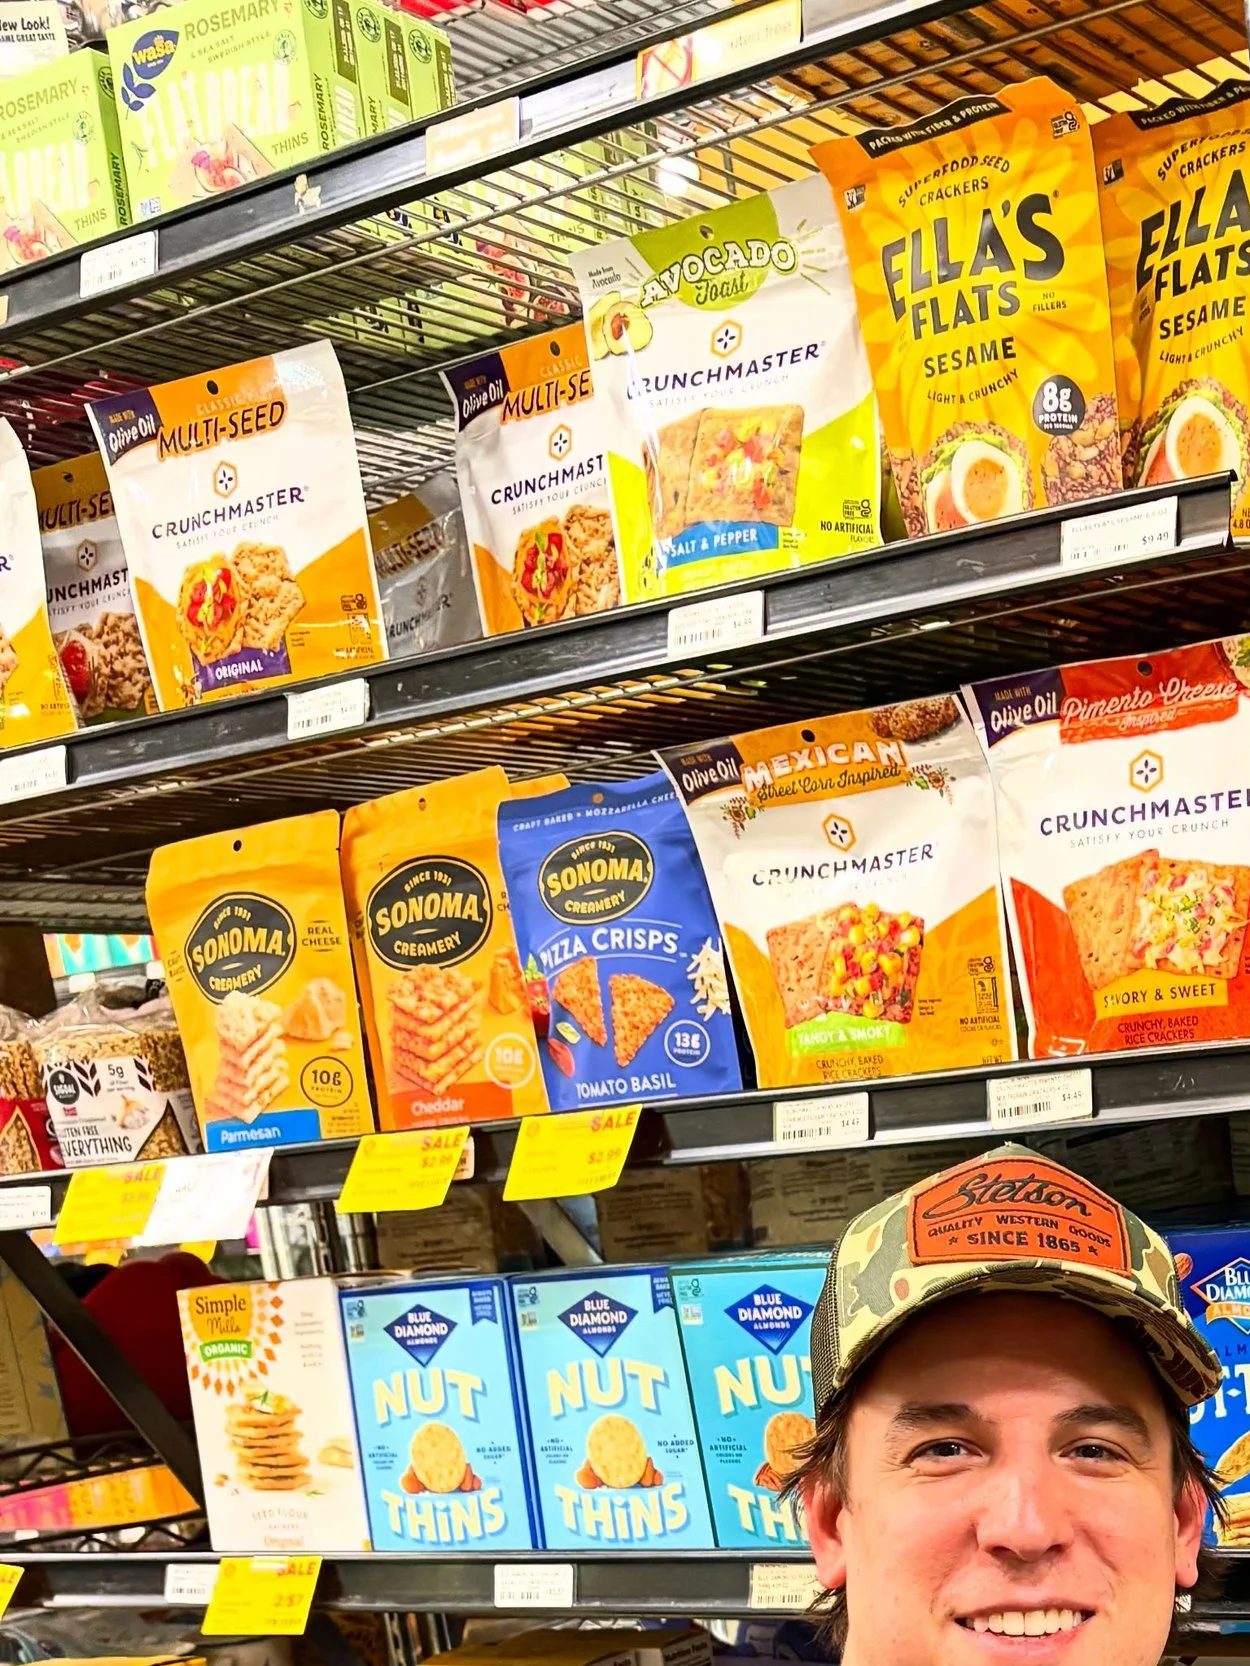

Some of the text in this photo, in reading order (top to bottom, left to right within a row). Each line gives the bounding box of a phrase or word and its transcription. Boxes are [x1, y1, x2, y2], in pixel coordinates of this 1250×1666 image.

[22, 18, 50, 32] Look!
[183, 0, 280, 42] ROSEMARY
[133, 40, 175, 66] wasa
[868, 129, 899, 152] PACKED
[924, 117, 951, 139] FIBER
[961, 100, 1001, 125] PROTEIN
[271, 131, 309, 155] THINS
[898, 155, 1011, 208] SUPERFOOD SEED
[919, 176, 990, 207] CRACKERS
[882, 192, 1065, 323] ELLA'S
[639, 238, 798, 309] AVOCADO
[694, 271, 749, 306] Toast
[1042, 291, 1056, 300] NO
[910, 280, 1021, 342] FLATS
[1032, 300, 1068, 313] FILLERS
[924, 336, 1018, 379] SESAME
[927, 369, 1020, 405] LIGHT CRUNCHY
[1041, 381, 1072, 413] 8g
[157, 400, 286, 459] MULTI-SEED
[1038, 412, 1079, 426] PROTEIN
[151, 487, 305, 540] CRUNCHMASTER
[669, 527, 759, 556] SALT & PEPPER
[820, 521, 875, 535] NO ARTIFICIAL
[1142, 531, 1170, 548] $9.49
[214, 659, 264, 680] ORIGINAL
[988, 693, 1059, 734] Olive Oil
[740, 738, 907, 791] MEXICAN
[757, 760, 901, 805] Street Corn Inspired
[513, 813, 574, 833] CRAFT BAKED
[1069, 818, 1231, 848] SATISFY YOUR CRUNCH
[301, 934, 342, 947] CHEESE
[307, 925, 335, 936] REAL
[590, 927, 679, 956] CRISPS
[190, 934, 284, 973] SONOMA
[208, 966, 263, 992] CREAMERY
[1169, 981, 1217, 1000] SWEET
[1117, 1014, 1199, 1035] CRUNCHY, BAKED
[1124, 1027, 1195, 1045] RICE CRACKERS
[673, 1030, 701, 1048] 13g
[310, 1068, 342, 1087] 10g
[574, 1071, 676, 1099] TOMATO BASIL
[411, 1096, 466, 1115] Cheddar
[220, 1124, 282, 1144] Parmesan
[589, 1109, 637, 1134] SALE
[922, 1172, 1092, 1222] Stetson
[927, 1214, 1112, 1248] QUALITY WESTERN GOODS
[967, 1231, 1081, 1253] SINCE 1865
[194, 1294, 247, 1318] Simple
[201, 1341, 250, 1358] ORGANIC
[371, 1366, 485, 1426] NUT
